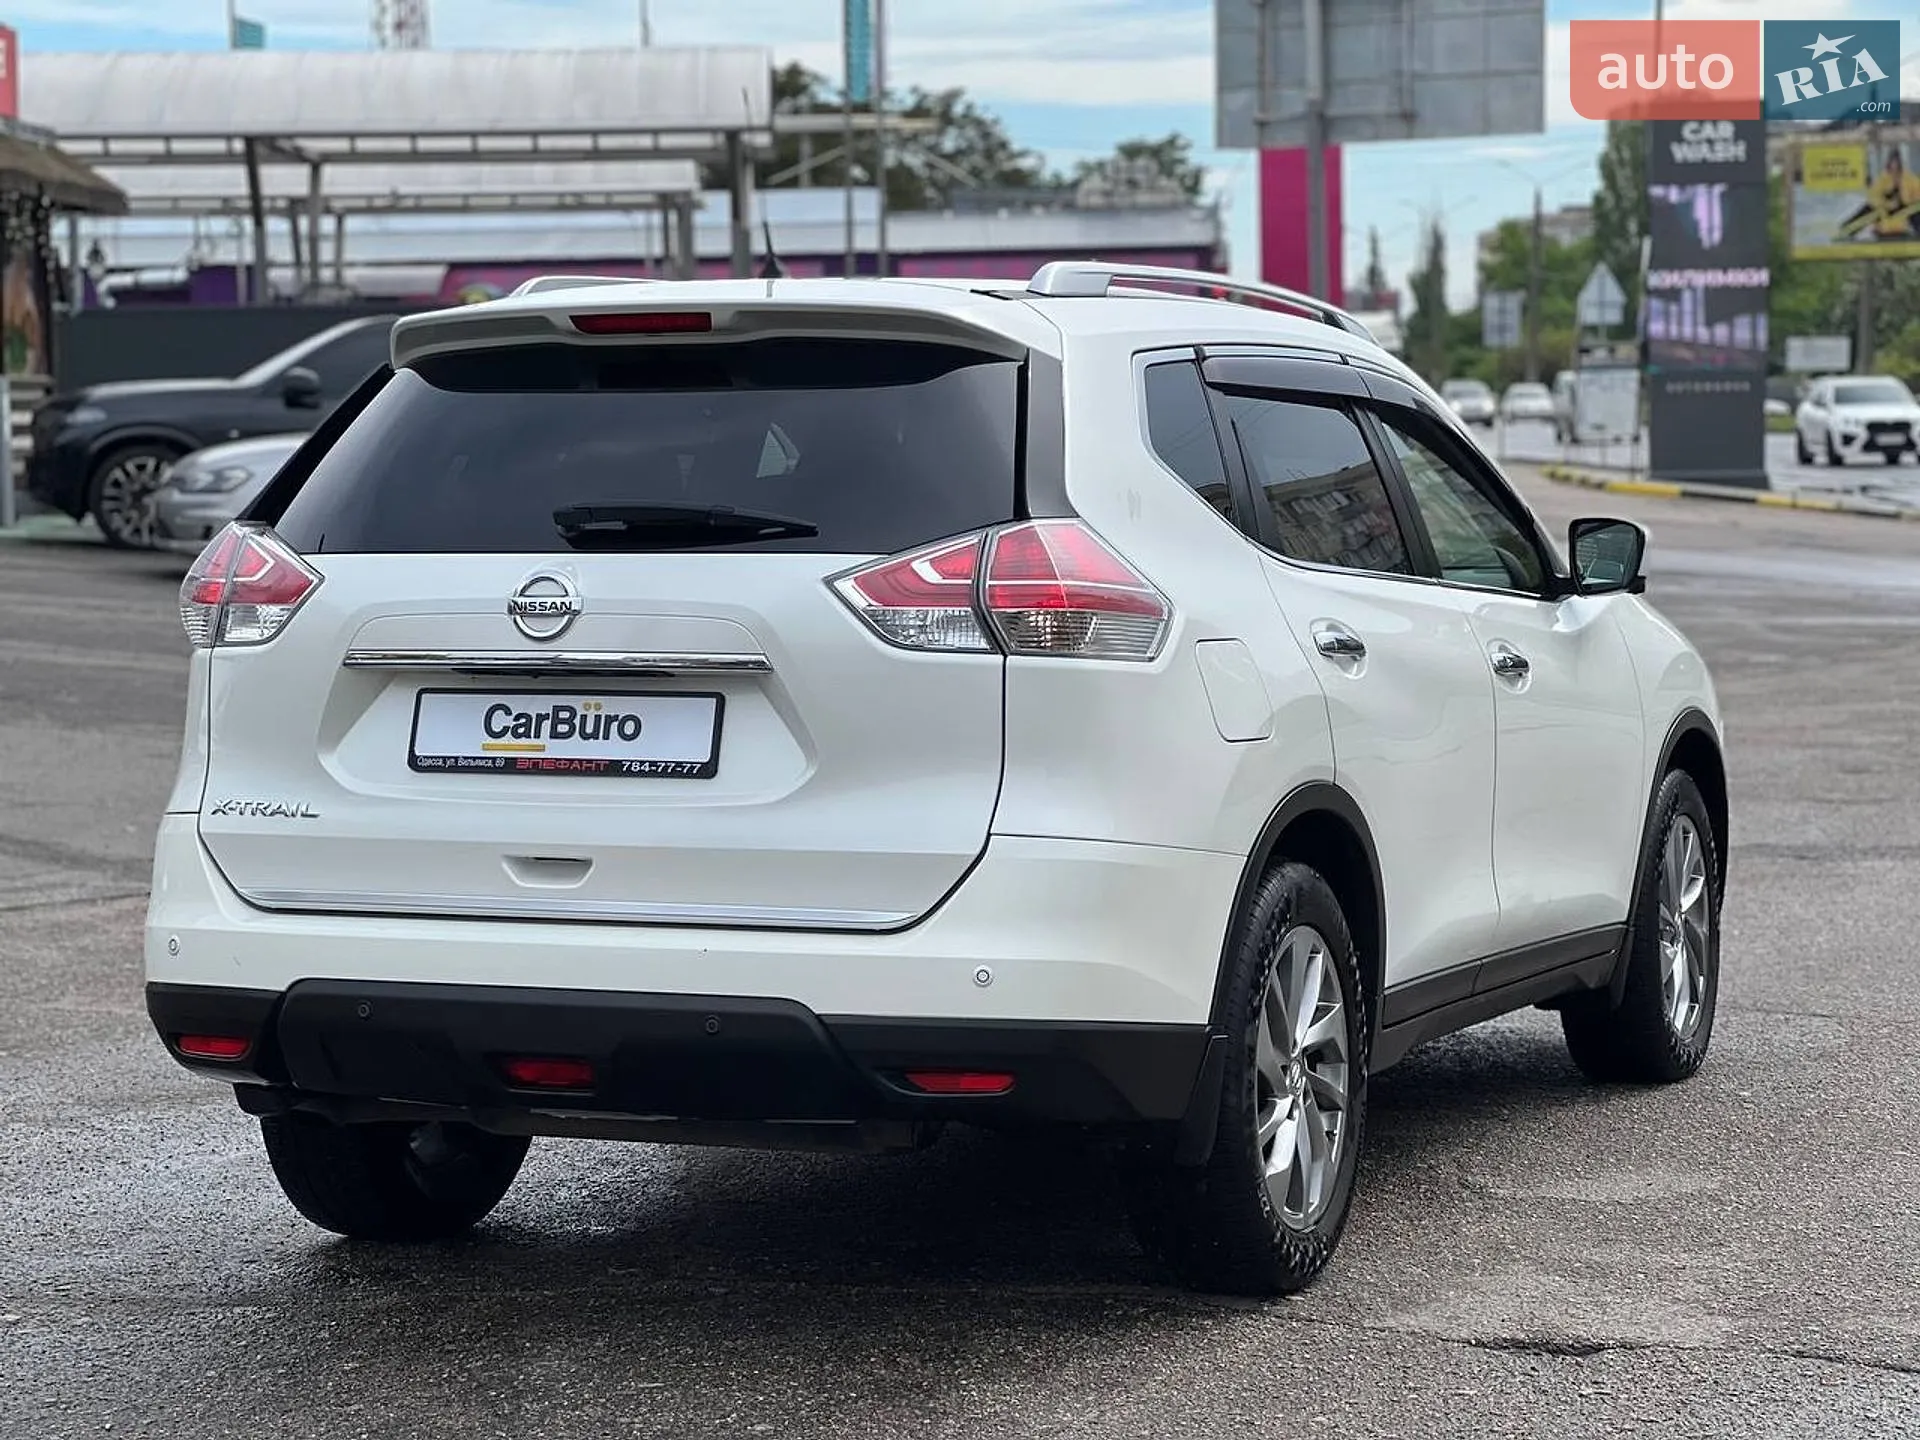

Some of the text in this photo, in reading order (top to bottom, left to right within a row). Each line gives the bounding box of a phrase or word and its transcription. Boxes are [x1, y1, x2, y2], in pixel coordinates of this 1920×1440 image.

[1681, 120, 1735, 142] CAR
[1669, 139, 1747, 164] WASH
[512, 600, 572, 612] NISSAN
[483, 701, 643, 742] CarBüro
[621, 760, 702, 775] 784-77-77
[211, 799, 321, 819] X-TRAIL
